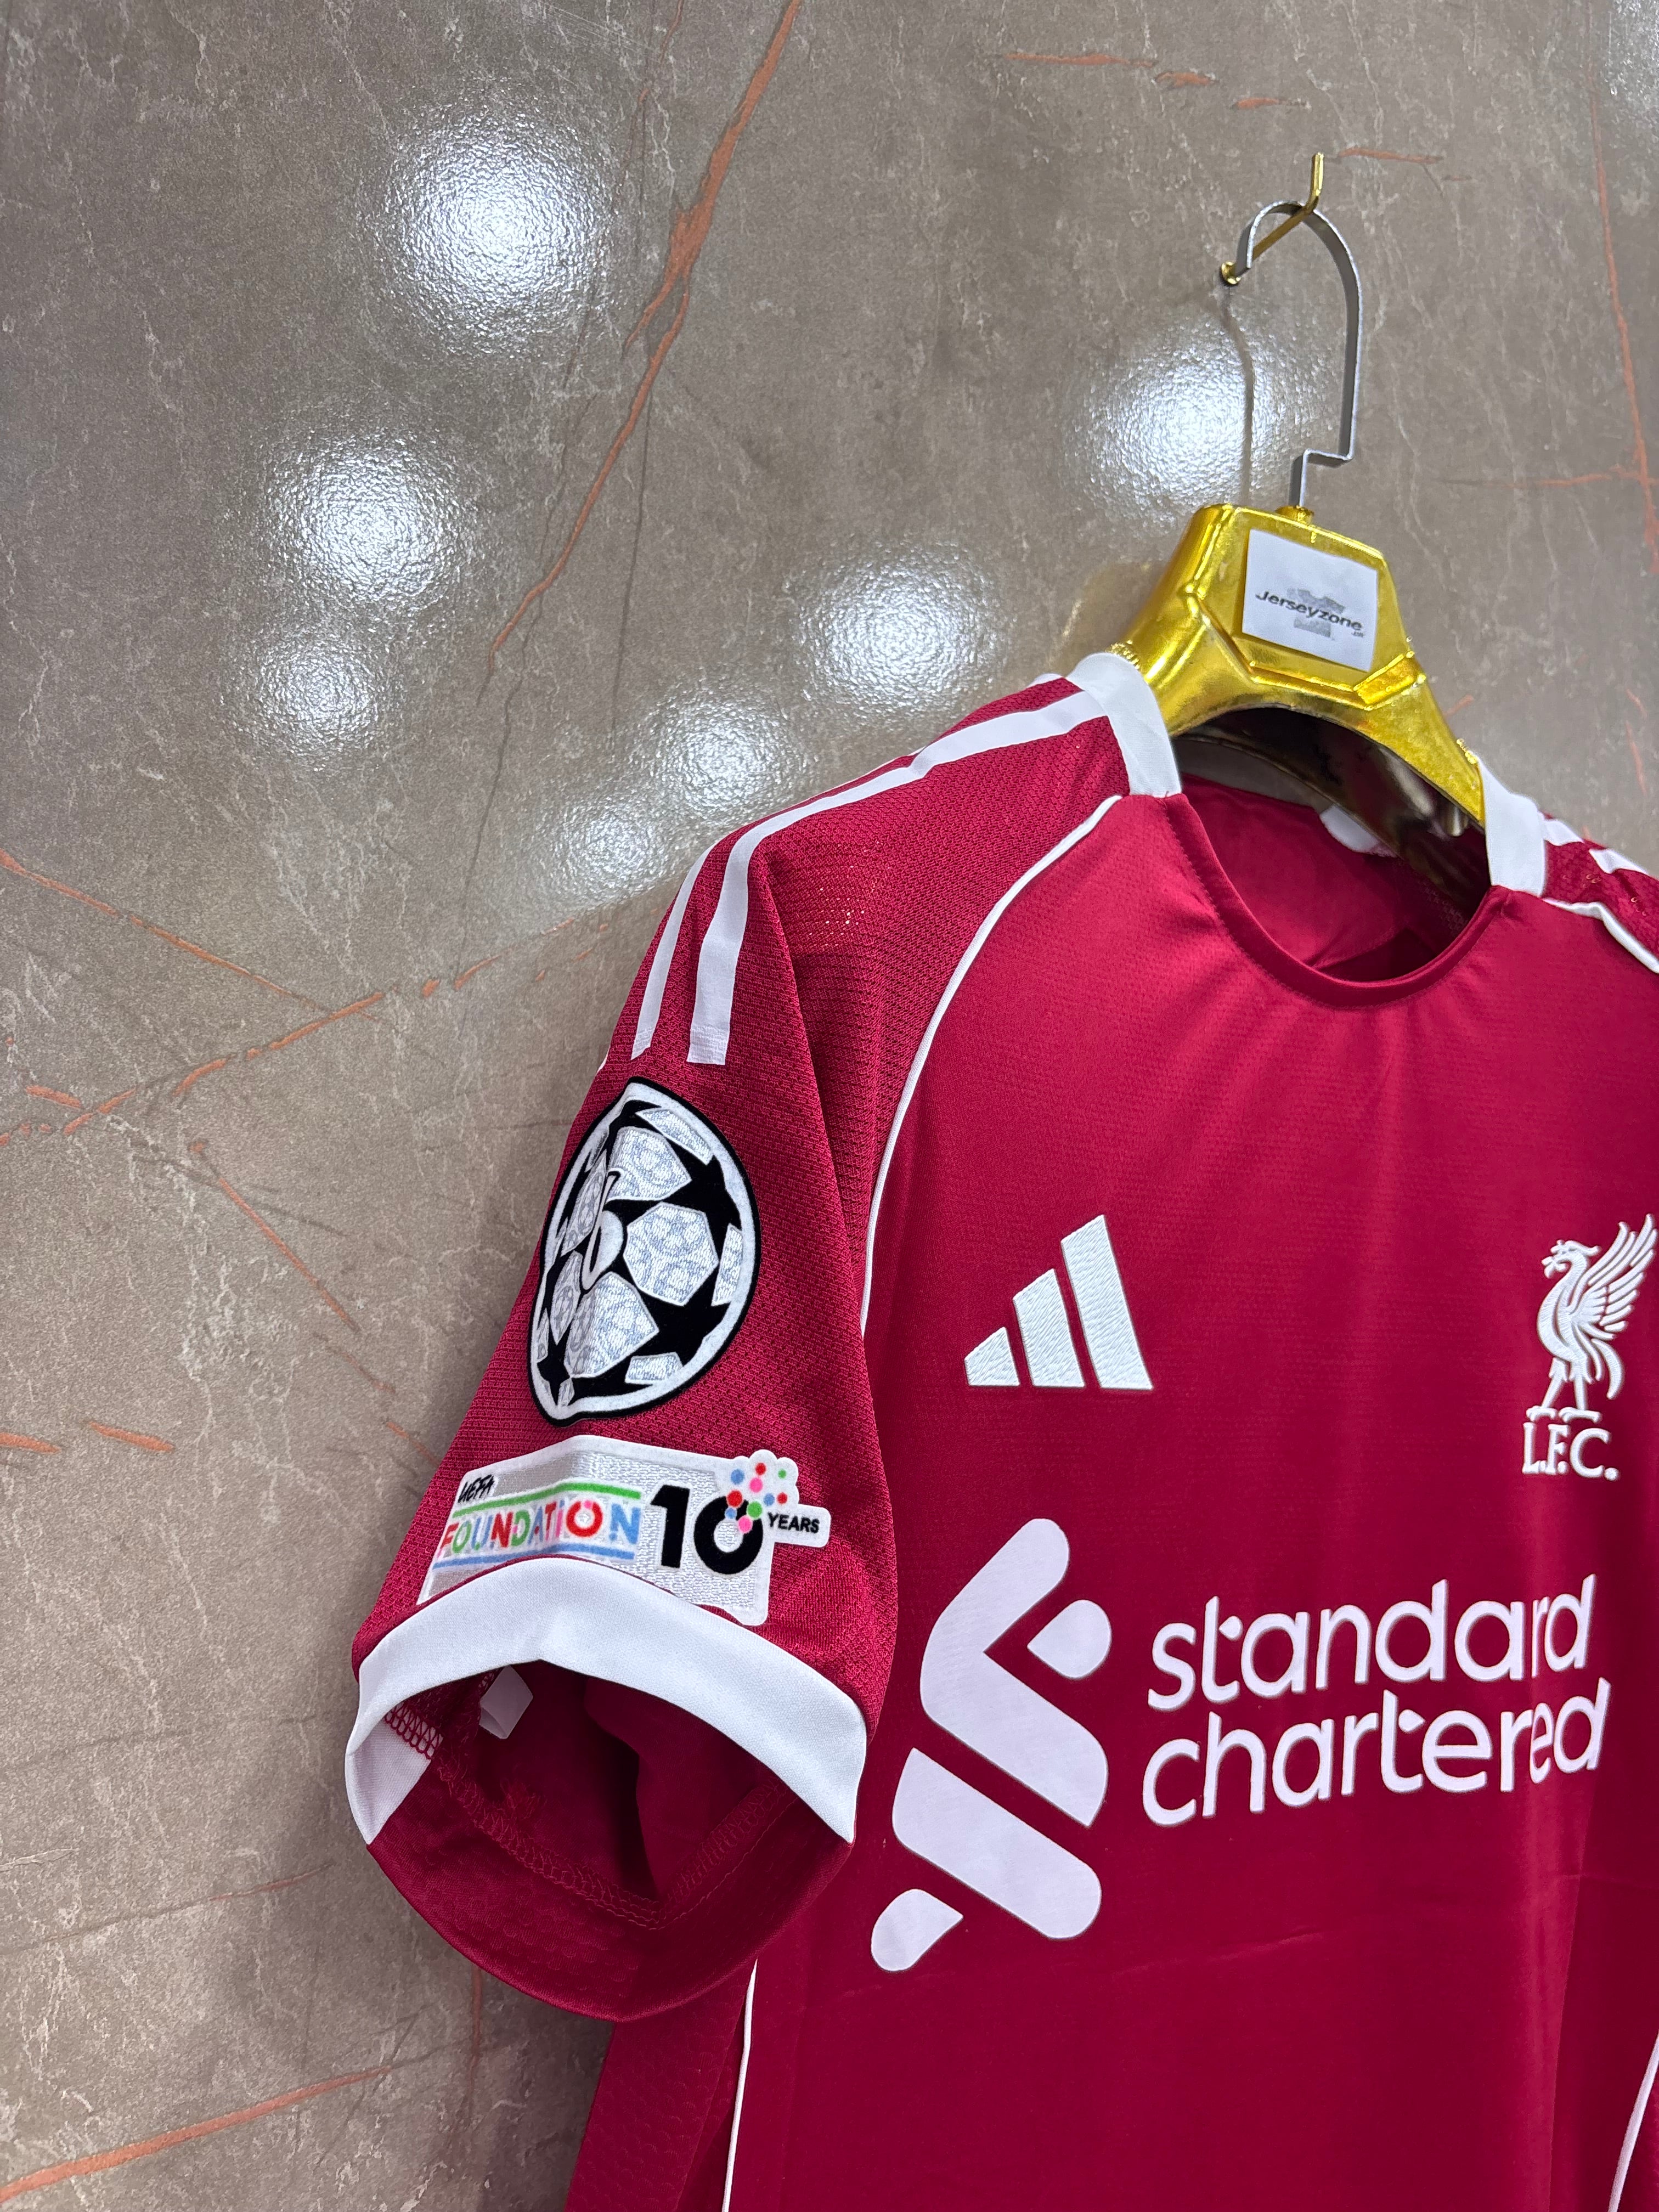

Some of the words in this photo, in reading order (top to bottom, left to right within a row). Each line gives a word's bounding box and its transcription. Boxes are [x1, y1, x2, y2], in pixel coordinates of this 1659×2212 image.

[1255, 590, 1363, 631] Jerseyzone
[437, 1499, 642, 1557] FOUNDATION
[650, 1484, 763, 1575] 10
[768, 1512, 821, 1534] YEARS
[458, 1474, 495, 1504] UEFA
[1147, 1573, 1597, 1711] standard
[1142, 1677, 1611, 1827] chartered
